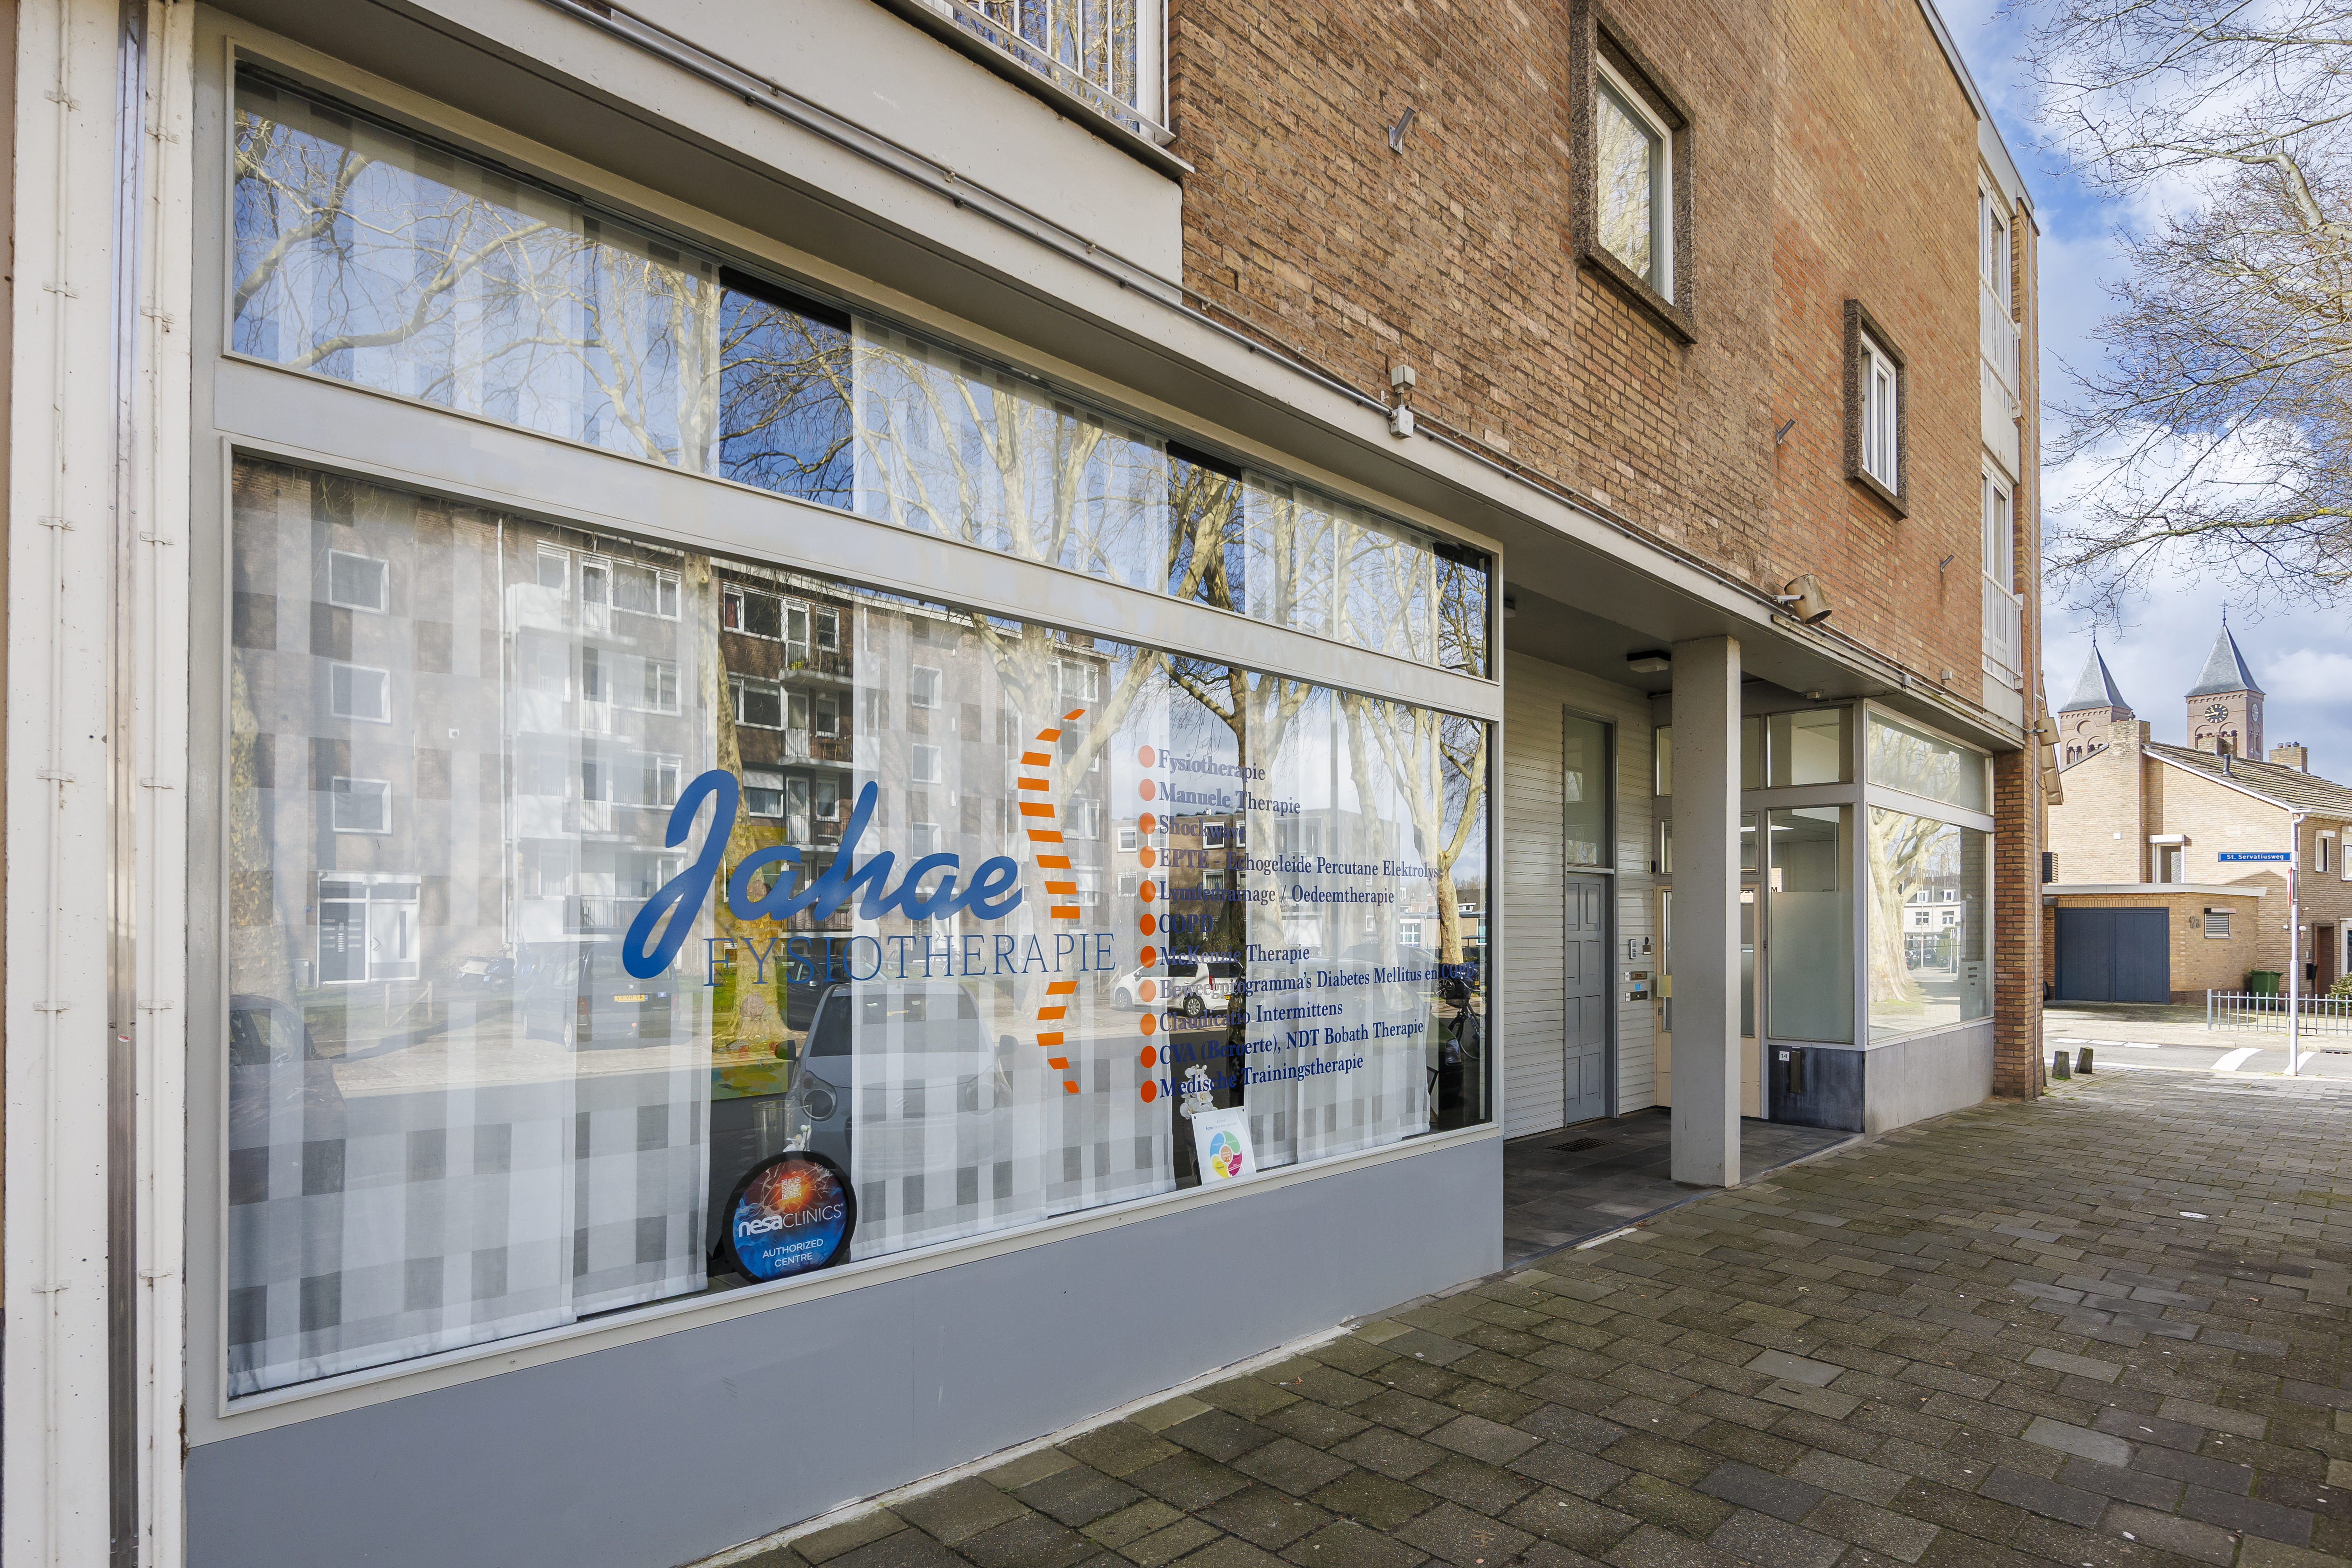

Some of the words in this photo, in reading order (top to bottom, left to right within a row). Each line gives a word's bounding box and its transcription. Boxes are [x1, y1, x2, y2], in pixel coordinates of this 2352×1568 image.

[1158, 749, 1266, 783] Fysiotherapie
[1159, 782, 1231, 808] Manuele
[1235, 790, 1301, 816] Therapie
[1159, 814, 1246, 840] Shockwave
[622, 769, 1021, 979] Jahae
[1159, 848, 1209, 869] EPTE
[1226, 852, 1312, 876] Echogeleide
[1316, 857, 1378, 876] Percutane
[1383, 860, 1444, 881] Elektrolyse
[1159, 881, 1276, 906] Lymfedrainage
[1292, 885, 1394, 906] Oedeemtherapie
[1159, 914, 1213, 934] COPD
[704, 933, 1117, 987] FYSIOTHERAPIE
[1159, 946, 1241, 965] McKenzie
[1246, 944, 1310, 965] Therapie
[1317, 969, 1370, 988] Diabetes
[1374, 965, 1422, 984] Mellitus
[1425, 969, 1438, 980] en
[1441, 962, 1474, 979] COPD
[1159, 1007, 1250, 1032] Claudicatio
[1256, 1001, 1343, 1023] Intermittens
[1159, 1041, 1197, 1065] CVA
[1202, 1034, 1282, 1063] (Beroerte),
[1286, 1029, 1319, 1049] NDT
[1324, 1024, 1369, 1044] Bobath
[1373, 1018, 1424, 1038] Therapie
[1159, 1071, 1237, 1098] Medische
[1241, 1053, 1364, 1086] Trainingstherapie
[762, 1239, 824, 1259] AUTHORIZED
[775, 1252, 813, 1267] CENTRE
